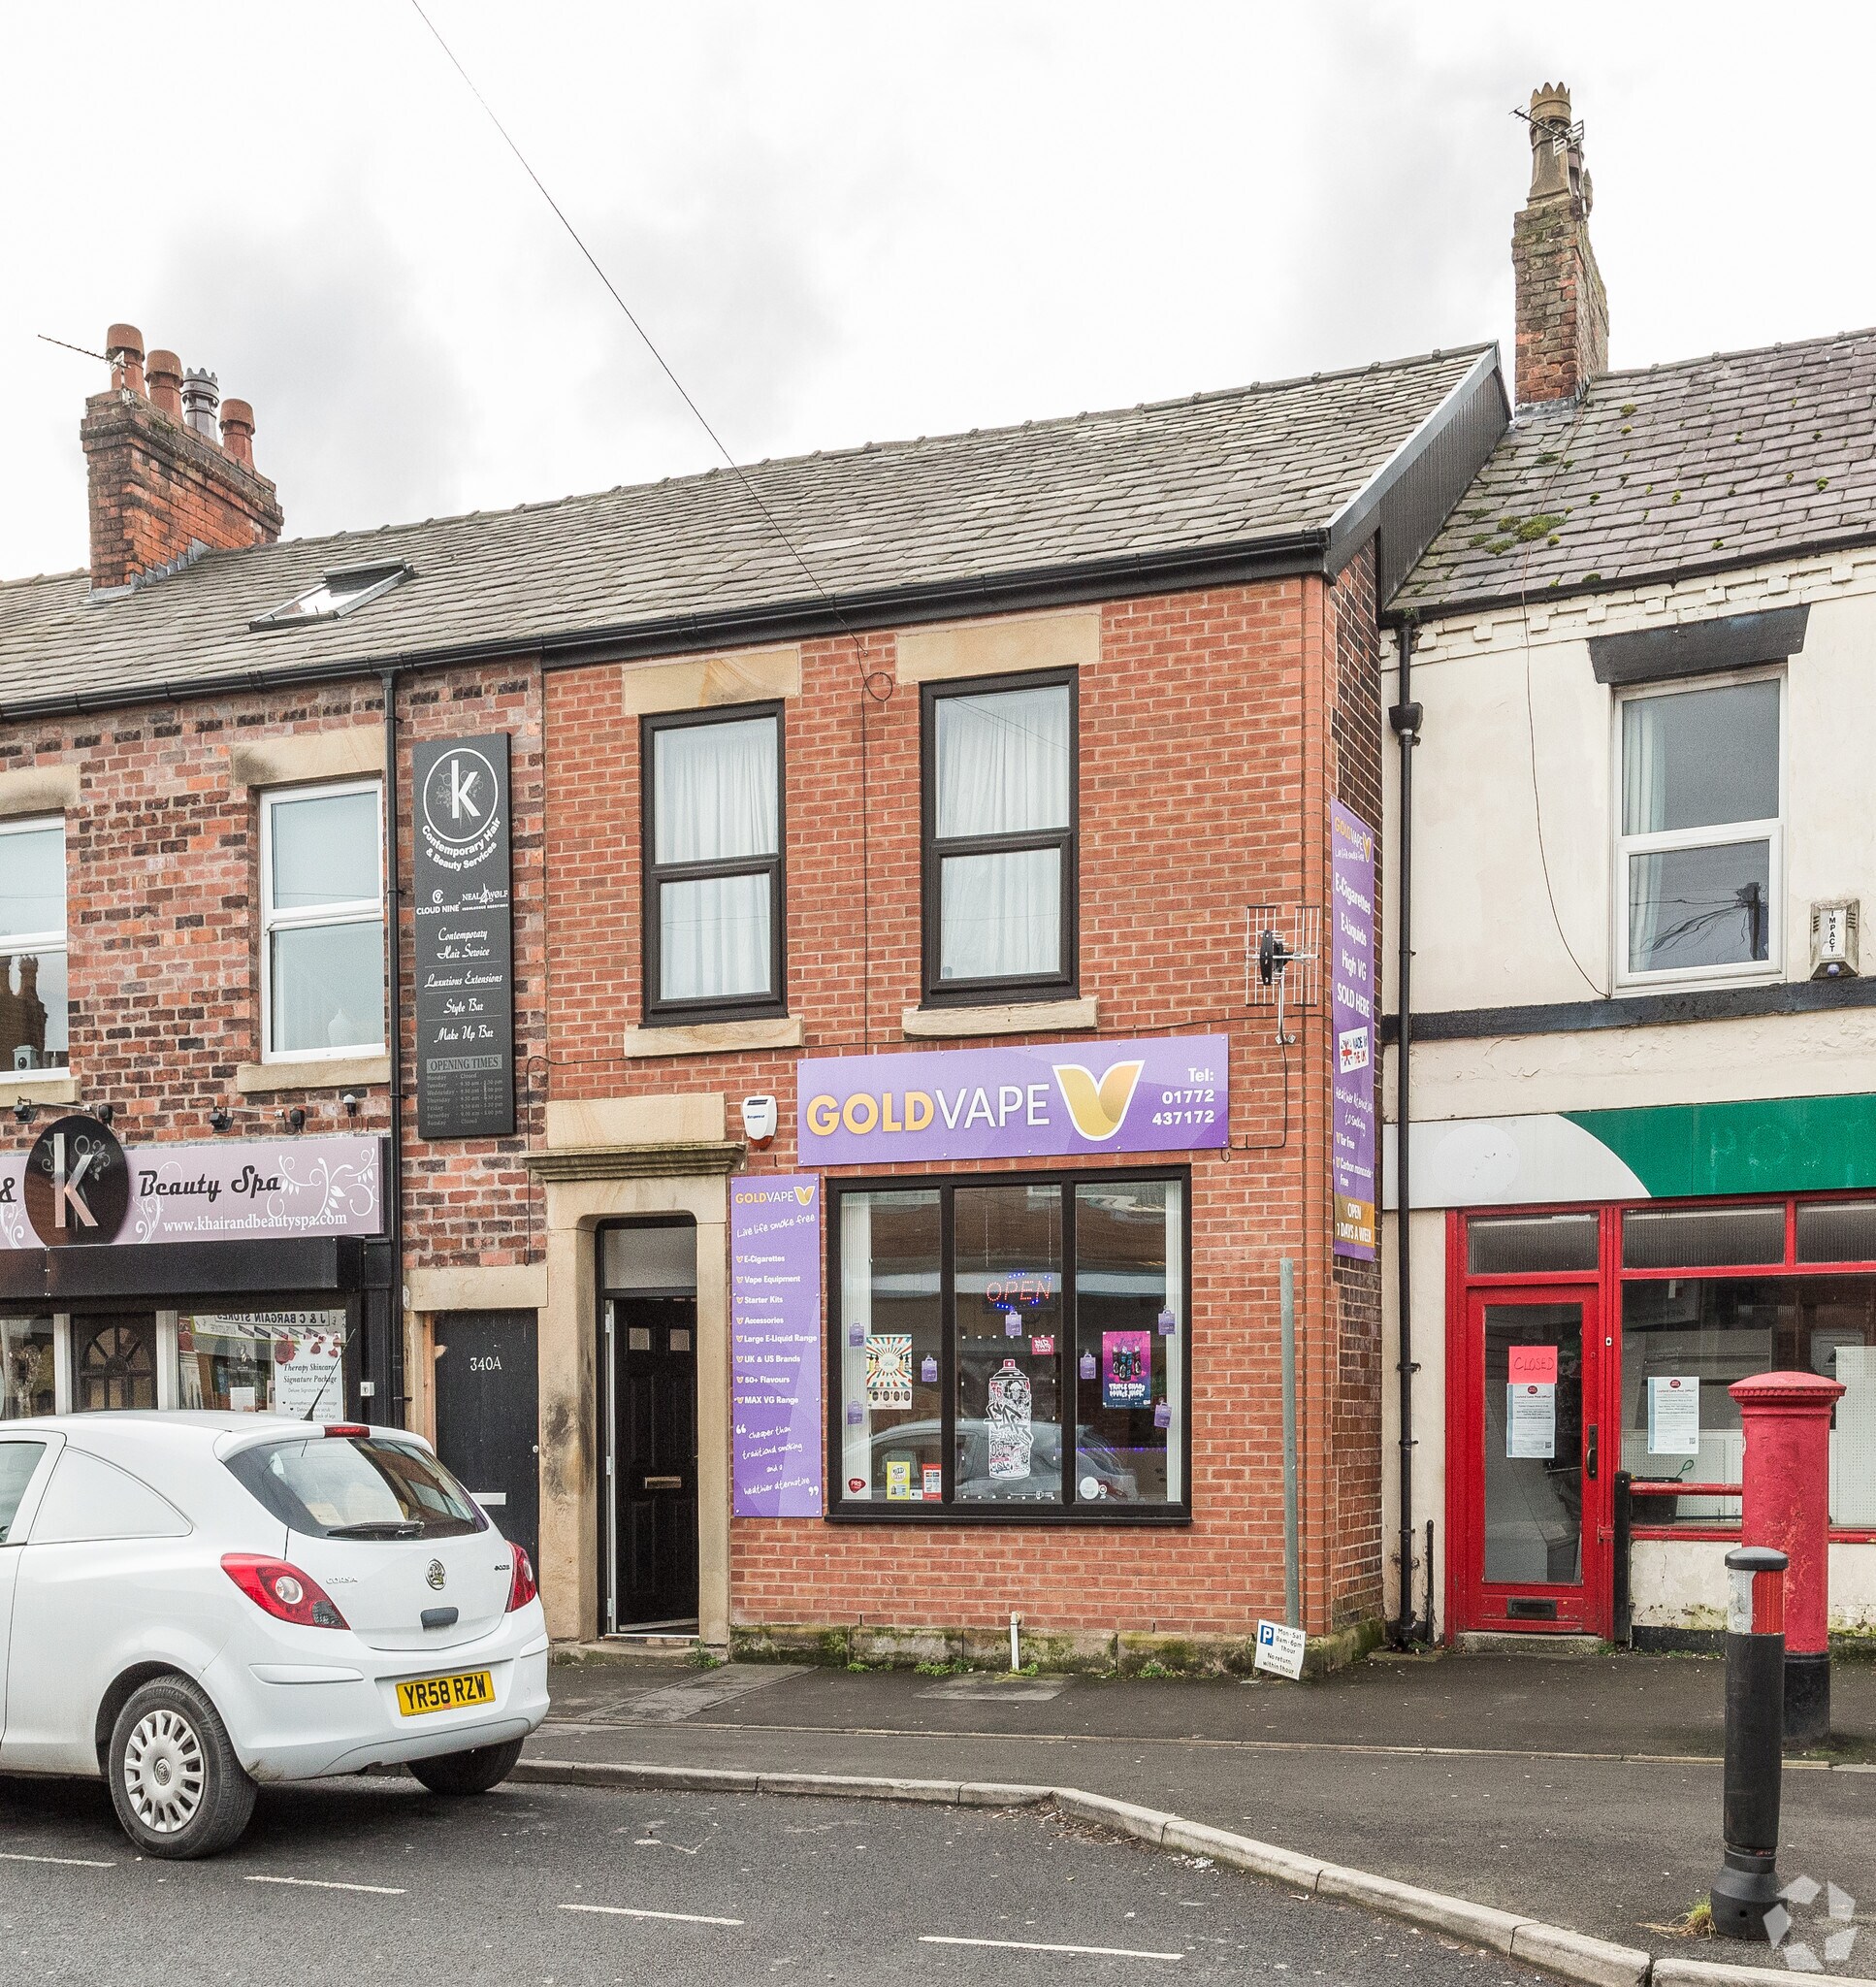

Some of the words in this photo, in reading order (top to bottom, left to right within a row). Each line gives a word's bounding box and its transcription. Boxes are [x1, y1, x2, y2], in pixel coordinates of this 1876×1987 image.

[422, 825, 485, 858] Contemporary
[484, 817, 501, 842] Hair
[426, 848, 433, 857] &
[433, 853, 462, 871] Beauty
[463, 841, 497, 868] Services
[462, 893, 481, 902] NEAL
[417, 906, 441, 915] CLOUD
[442, 904, 459, 913] NINE
[438, 927, 488, 942] Contemporary
[436, 945, 460, 959] Hair
[462, 943, 490, 958] Service
[1342, 948, 1357, 978] High
[1358, 958, 1367, 981] VG
[424, 974, 462, 988] Luxurious
[464, 970, 503, 985] Extensions
[443, 999, 466, 1016] Style
[468, 997, 484, 1011] Bar
[1337, 982, 1355, 1009] SOLD
[1355, 992, 1370, 1019] HERE
[434, 1027, 459, 1043] Make
[461, 1025, 475, 1041] Up
[478, 1025, 494, 1038] Bar
[430, 1058, 469, 1072] OPENING
[471, 1057, 498, 1068] TIMES
[1188, 1067, 1214, 1083] Tel:
[1161, 1089, 1215, 1105] 01772
[806, 1083, 1051, 1137] GOLDVAPE
[1151, 1109, 1215, 1126] 437172
[0, 1177, 17, 1203] &
[138, 1170, 222, 1202] Beauty
[231, 1165, 281, 1199] Spa
[735, 1191, 794, 1204] GOLDVAPE
[1347, 1202, 1362, 1221] OPEN
[162, 1212, 347, 1233] www.khairandbeautyspa.com
[737, 1226, 753, 1238] Live
[770, 1216, 794, 1231] smoke
[796, 1213, 815, 1224] free
[1340, 1224, 1354, 1240] DAYS
[1359, 1228, 1372, 1243] WEEK
[744, 1255, 785, 1264] E-Cigarettes
[744, 1276, 762, 1284] Vape
[764, 1275, 801, 1284] Equipment
[987, 1280, 1051, 1301] OPEN
[744, 1335, 764, 1344] Large
[765, 1334, 793, 1344] E-Liquid
[794, 1334, 817, 1343] Range
[470, 1356, 502, 1371] 340A
[776, 1355, 801, 1363] Brands
[1514, 1357, 1554, 1371] CLOSED
[284, 1363, 308, 1373] Therapy
[283, 1376, 313, 1385] Signature
[776, 1396, 799, 1405] Range
[748, 1428, 774, 1439] cheaper
[775, 1423, 791, 1435] than
[742, 1444, 777, 1460] traditional
[777, 1442, 803, 1452] smoking
[744, 1483, 773, 1496] healthier
[326, 1576, 358, 1584] CORSA
[1262, 1627, 1272, 1643] P
[404, 1680, 451, 1710] YR58
[453, 1674, 487, 1702] RZW
